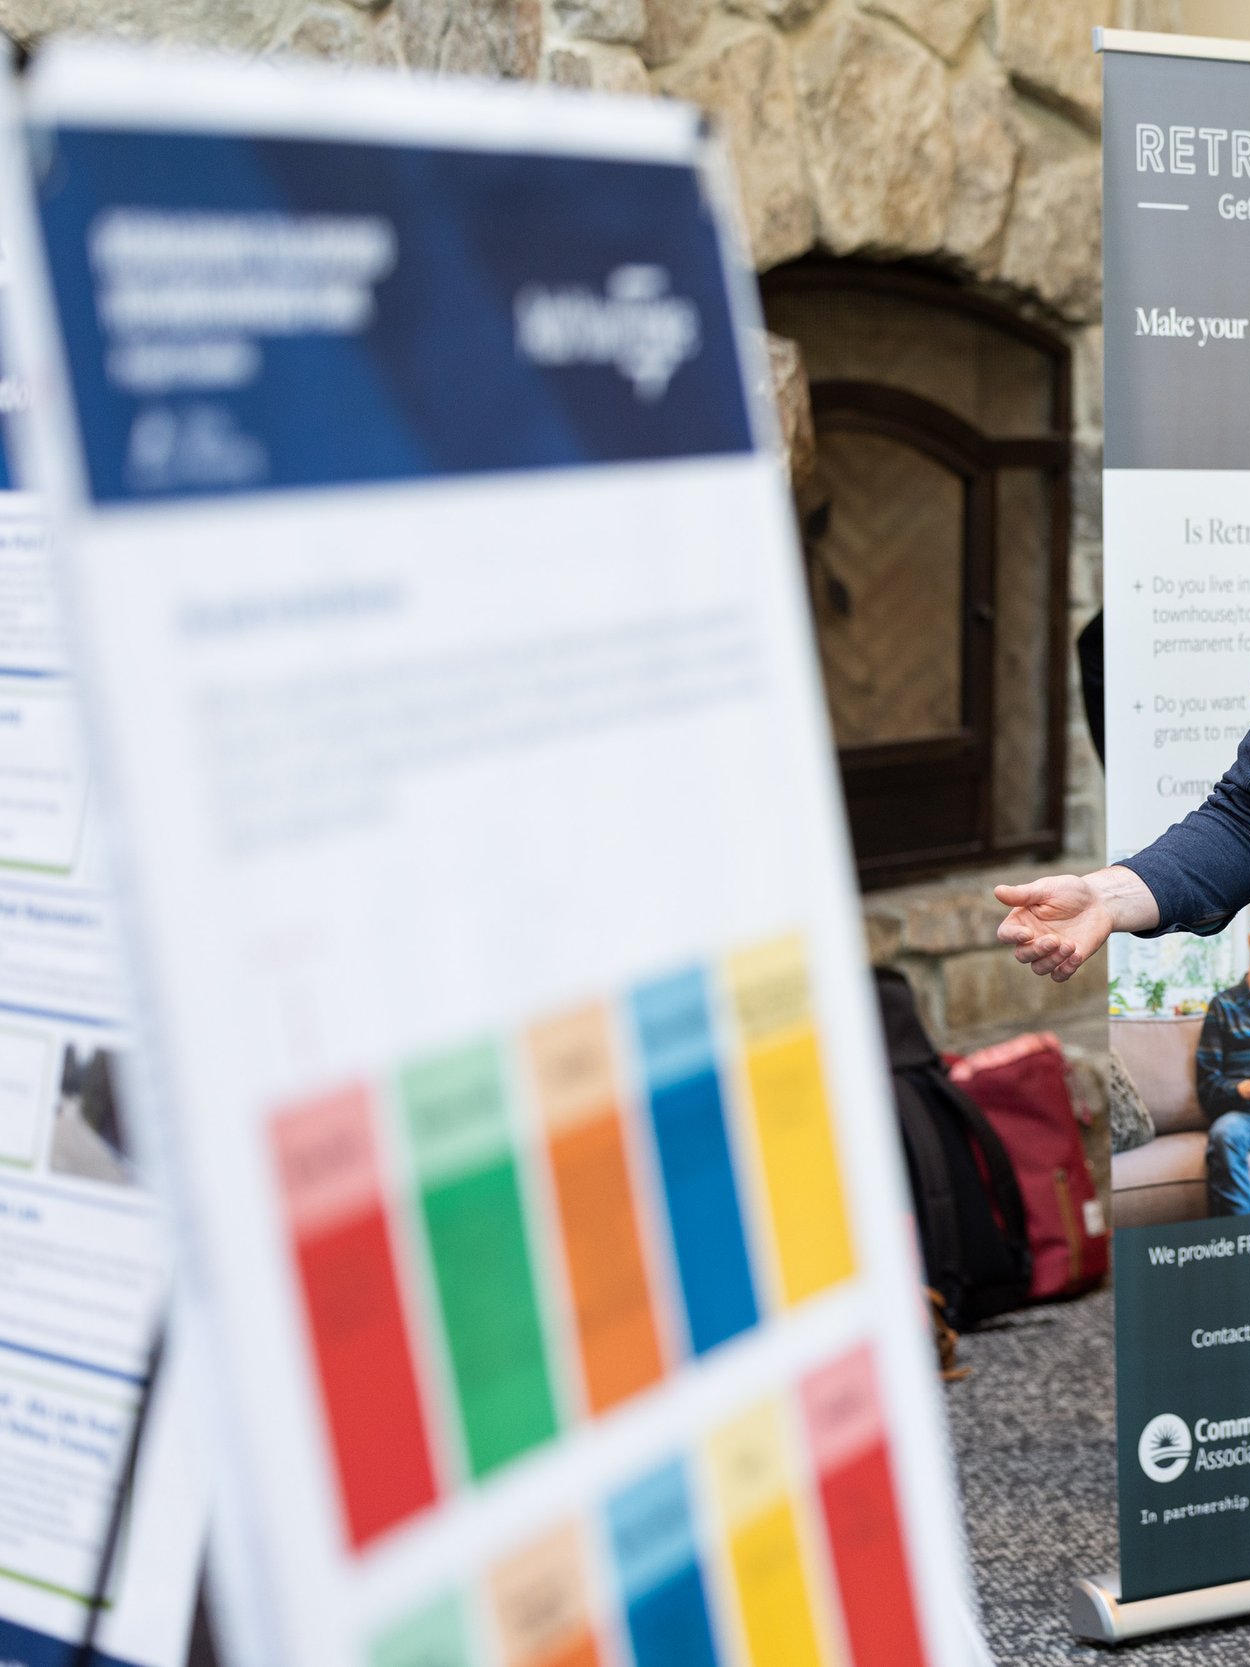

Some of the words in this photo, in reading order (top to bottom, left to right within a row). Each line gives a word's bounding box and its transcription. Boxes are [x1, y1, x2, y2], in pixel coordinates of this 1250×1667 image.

[1135, 307, 1195, 337] Make
[1198, 316, 1249, 347] your
[1184, 518, 1202, 545] Is
[1152, 575, 1175, 594] Do
[1178, 579, 1206, 599] you
[1208, 575, 1234, 594] live
[1237, 575, 1250, 594] in
[1153, 637, 1235, 659] permanent
[1153, 694, 1176, 713] Do
[1178, 697, 1206, 718] you
[1211, 696, 1246, 712] want
[1153, 725, 1200, 749] grants
[1204, 726, 1220, 741] to
[1148, 1246, 1176, 1265] We
[1177, 1236, 1235, 1268] provide
[1140, 1509, 1158, 1525] In
[1163, 1494, 1250, 1525] partnership
